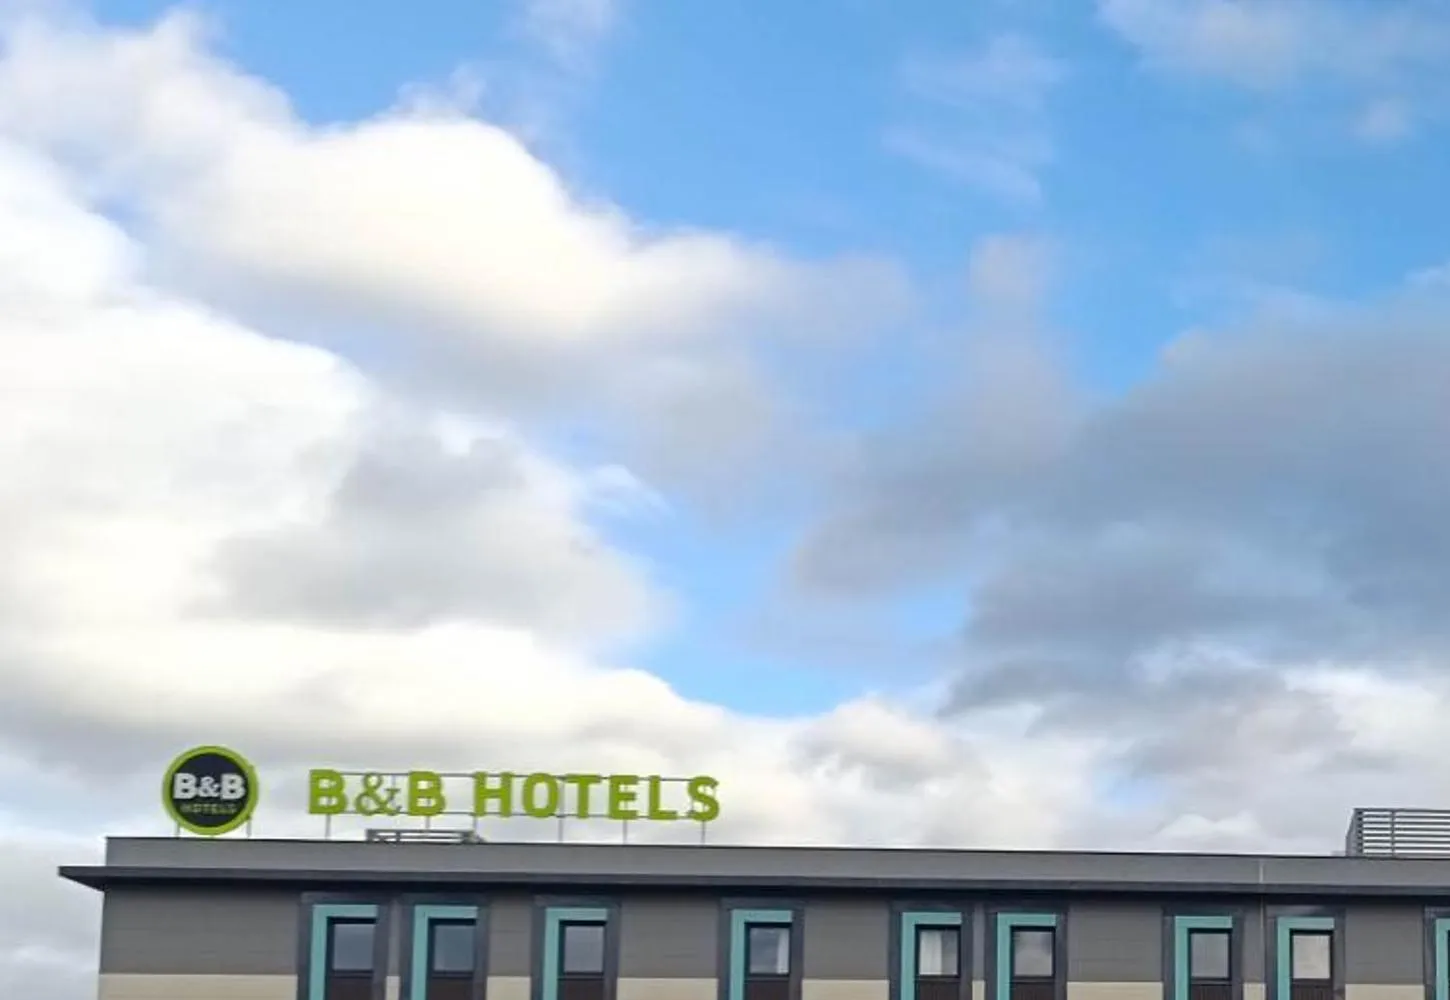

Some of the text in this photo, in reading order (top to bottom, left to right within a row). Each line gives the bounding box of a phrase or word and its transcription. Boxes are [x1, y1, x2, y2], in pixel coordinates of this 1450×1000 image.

[174, 773, 246, 799] B&B
[309, 769, 719, 821] B&B HOTELS
